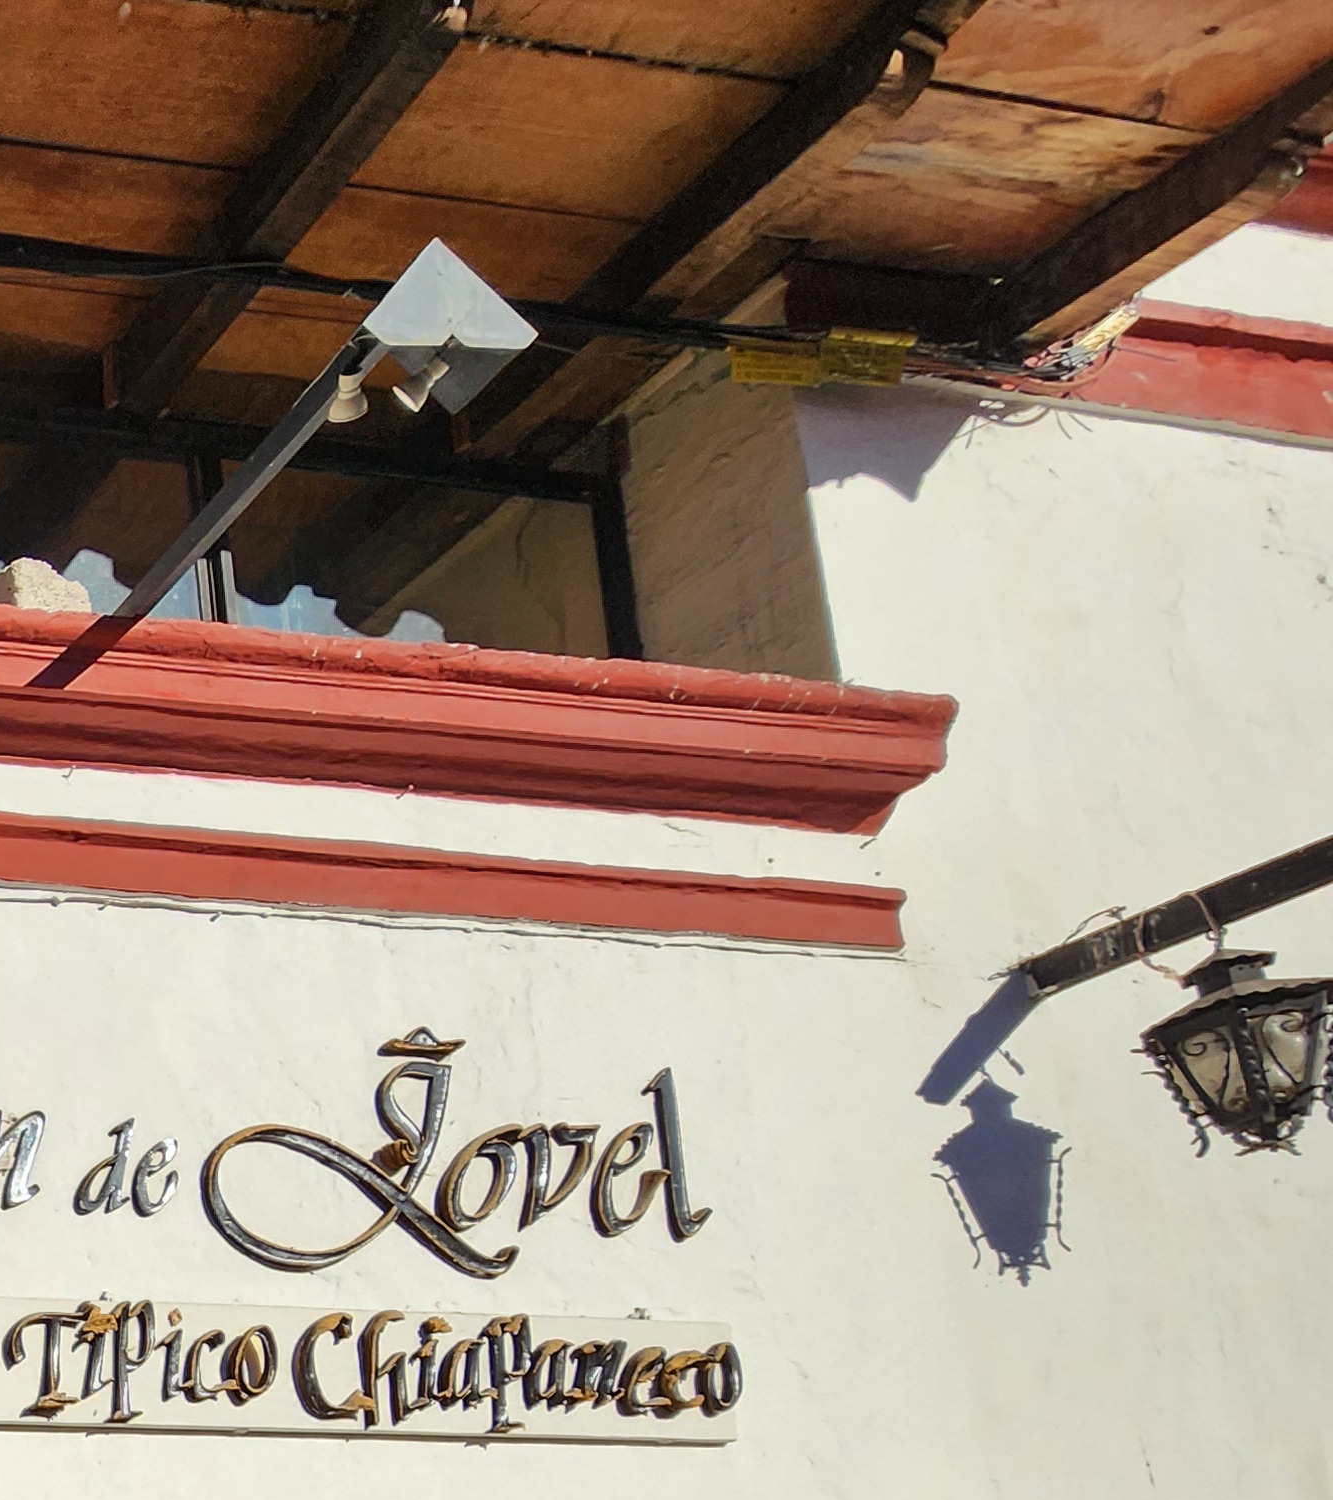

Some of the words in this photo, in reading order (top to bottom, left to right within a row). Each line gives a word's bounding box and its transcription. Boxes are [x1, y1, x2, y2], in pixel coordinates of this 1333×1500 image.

[73, 1117, 179, 1218] de
[200, 1026, 713, 1280] Jovel
[291, 1309, 744, 1434] Chiapaneco
